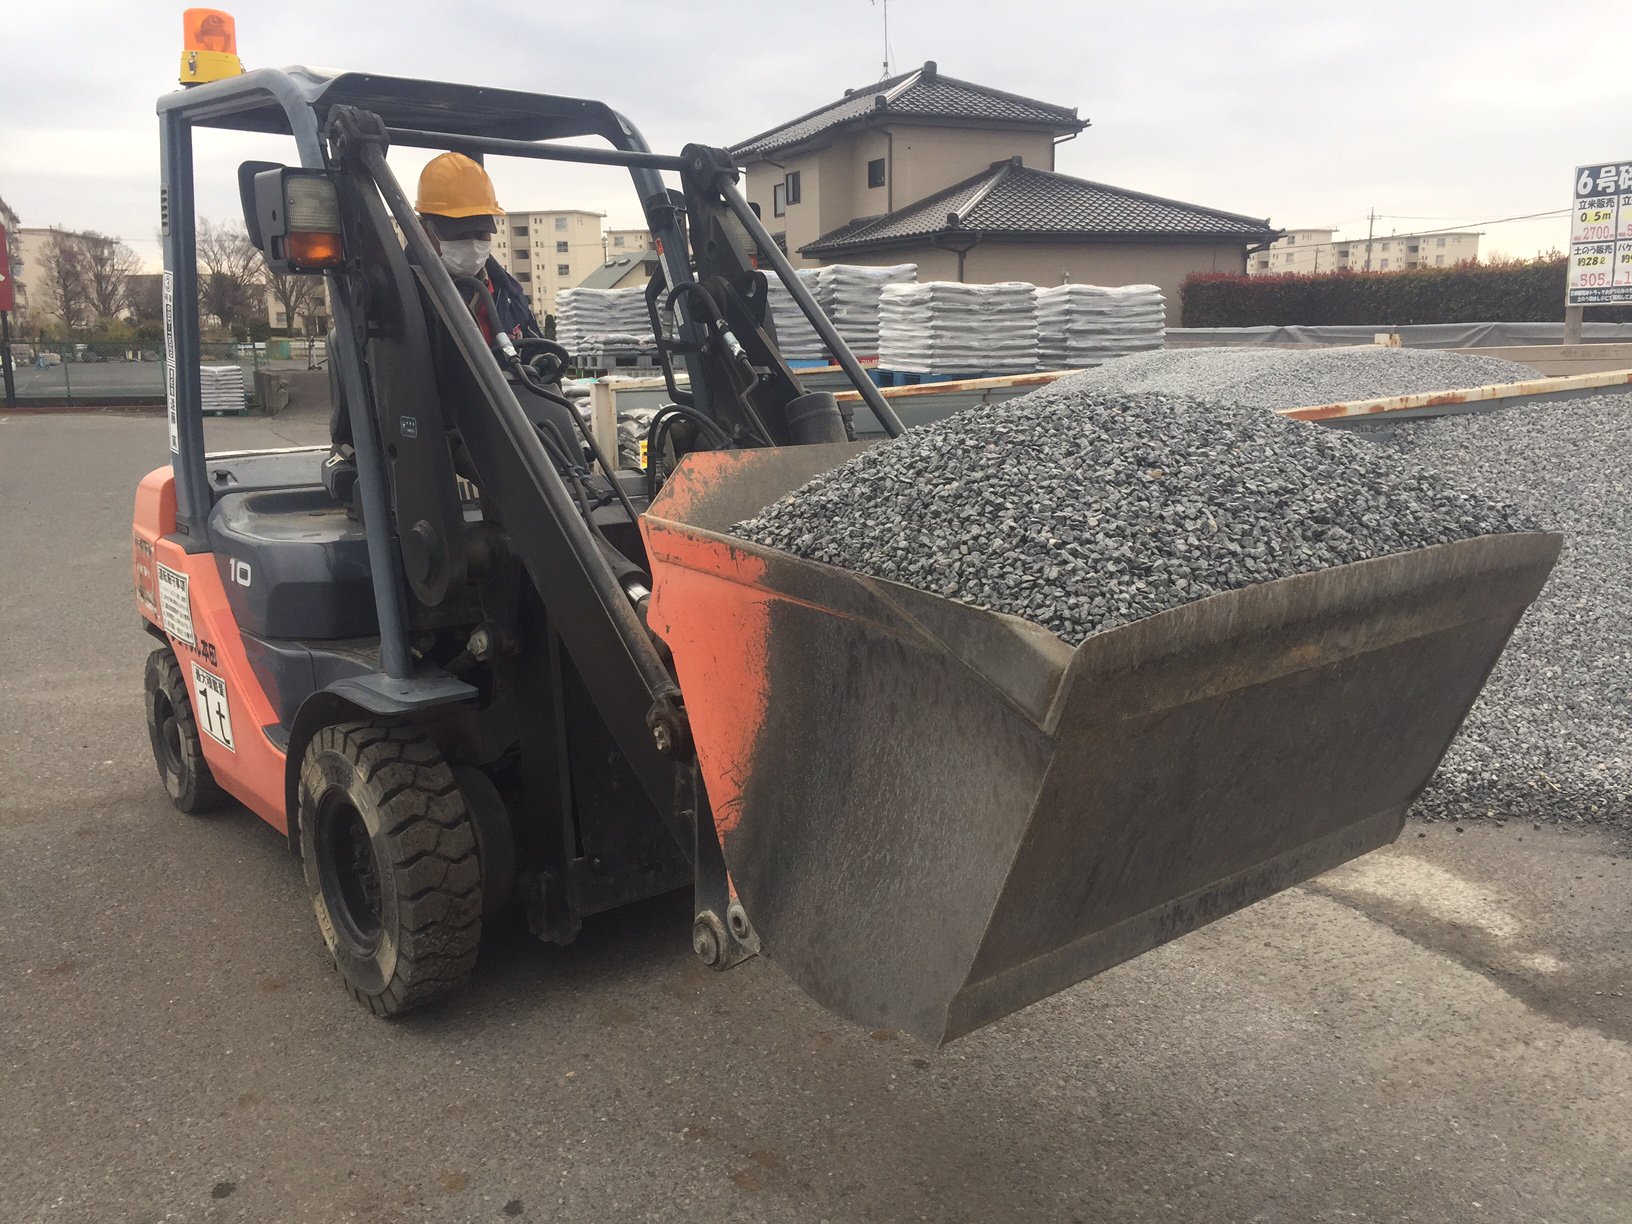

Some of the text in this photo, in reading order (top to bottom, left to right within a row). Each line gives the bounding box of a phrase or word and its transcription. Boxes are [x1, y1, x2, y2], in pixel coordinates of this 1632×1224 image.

[1578, 198, 1615, 210] 立米販売
[1574, 245, 1613, 255] 土のう販売
[230, 558, 251, 587] 10
[199, 688, 231, 745] 1t
